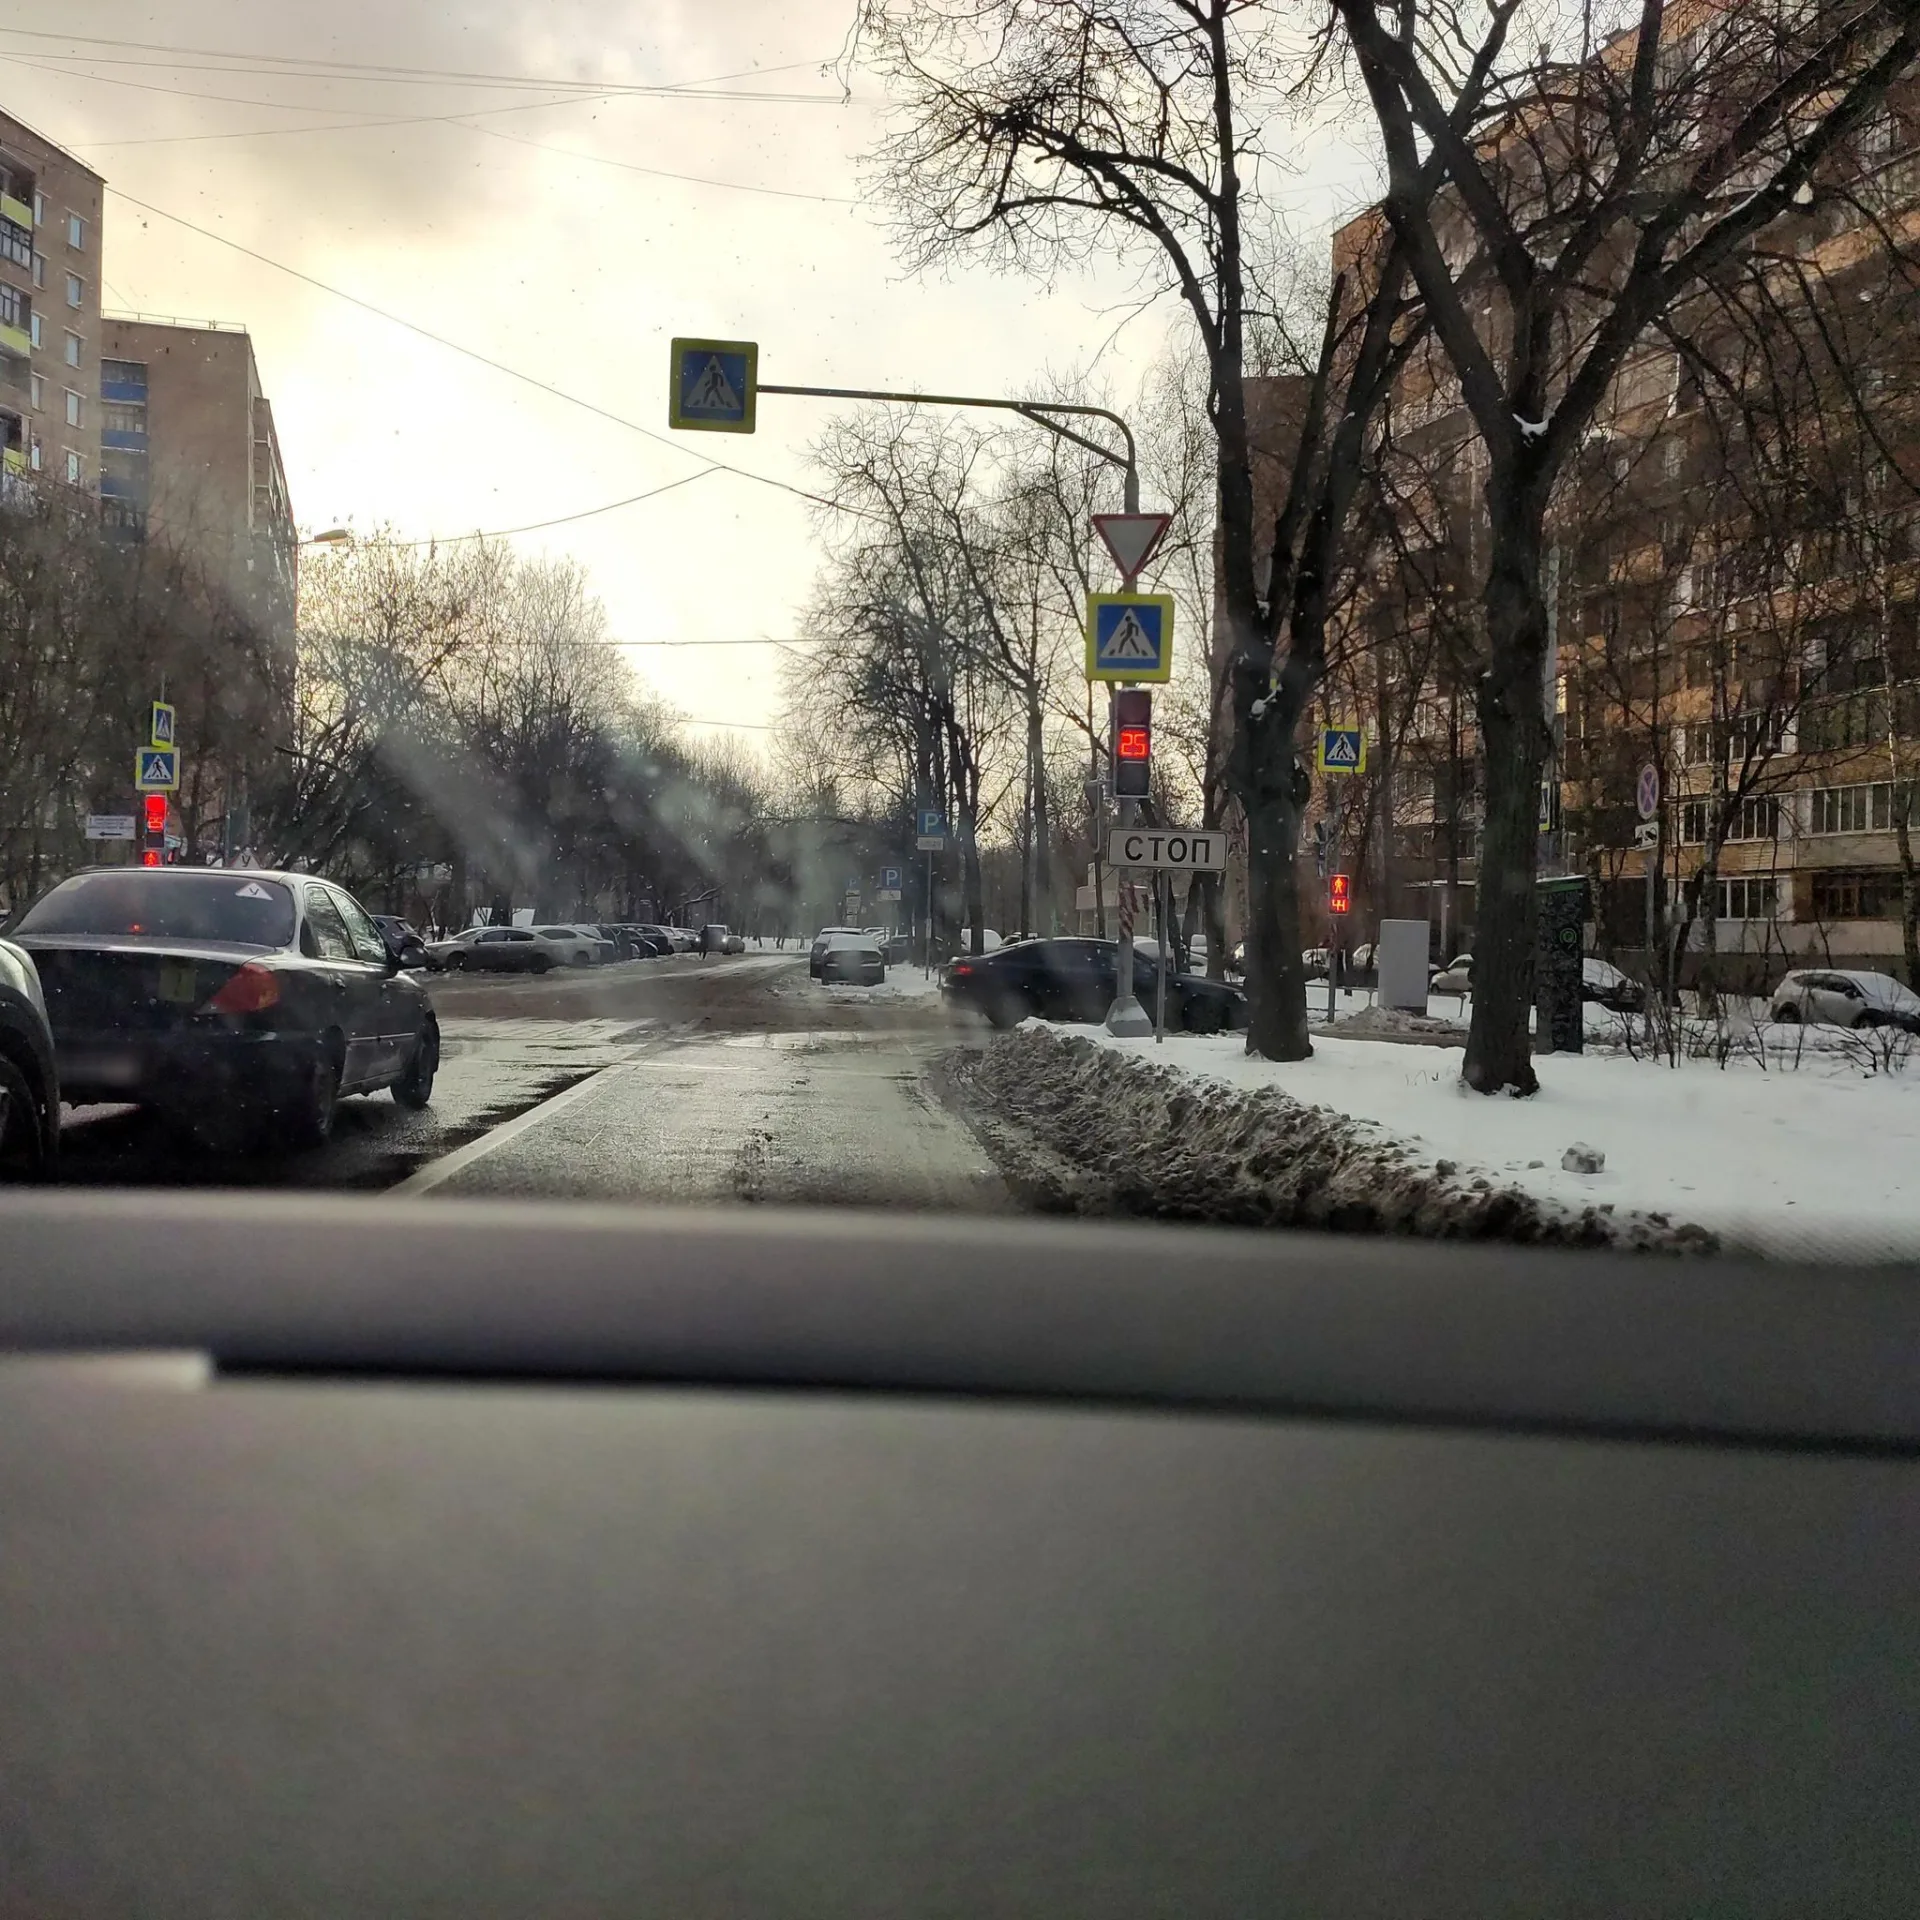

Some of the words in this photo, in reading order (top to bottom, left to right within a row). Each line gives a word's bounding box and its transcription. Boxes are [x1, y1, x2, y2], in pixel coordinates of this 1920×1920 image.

[1120, 732, 1146, 755] 25
[924, 813, 940, 834] P
[1124, 836, 1211, 864] СТОП
[886, 869, 898, 886] P
[1331, 899, 1346, 911] 44
